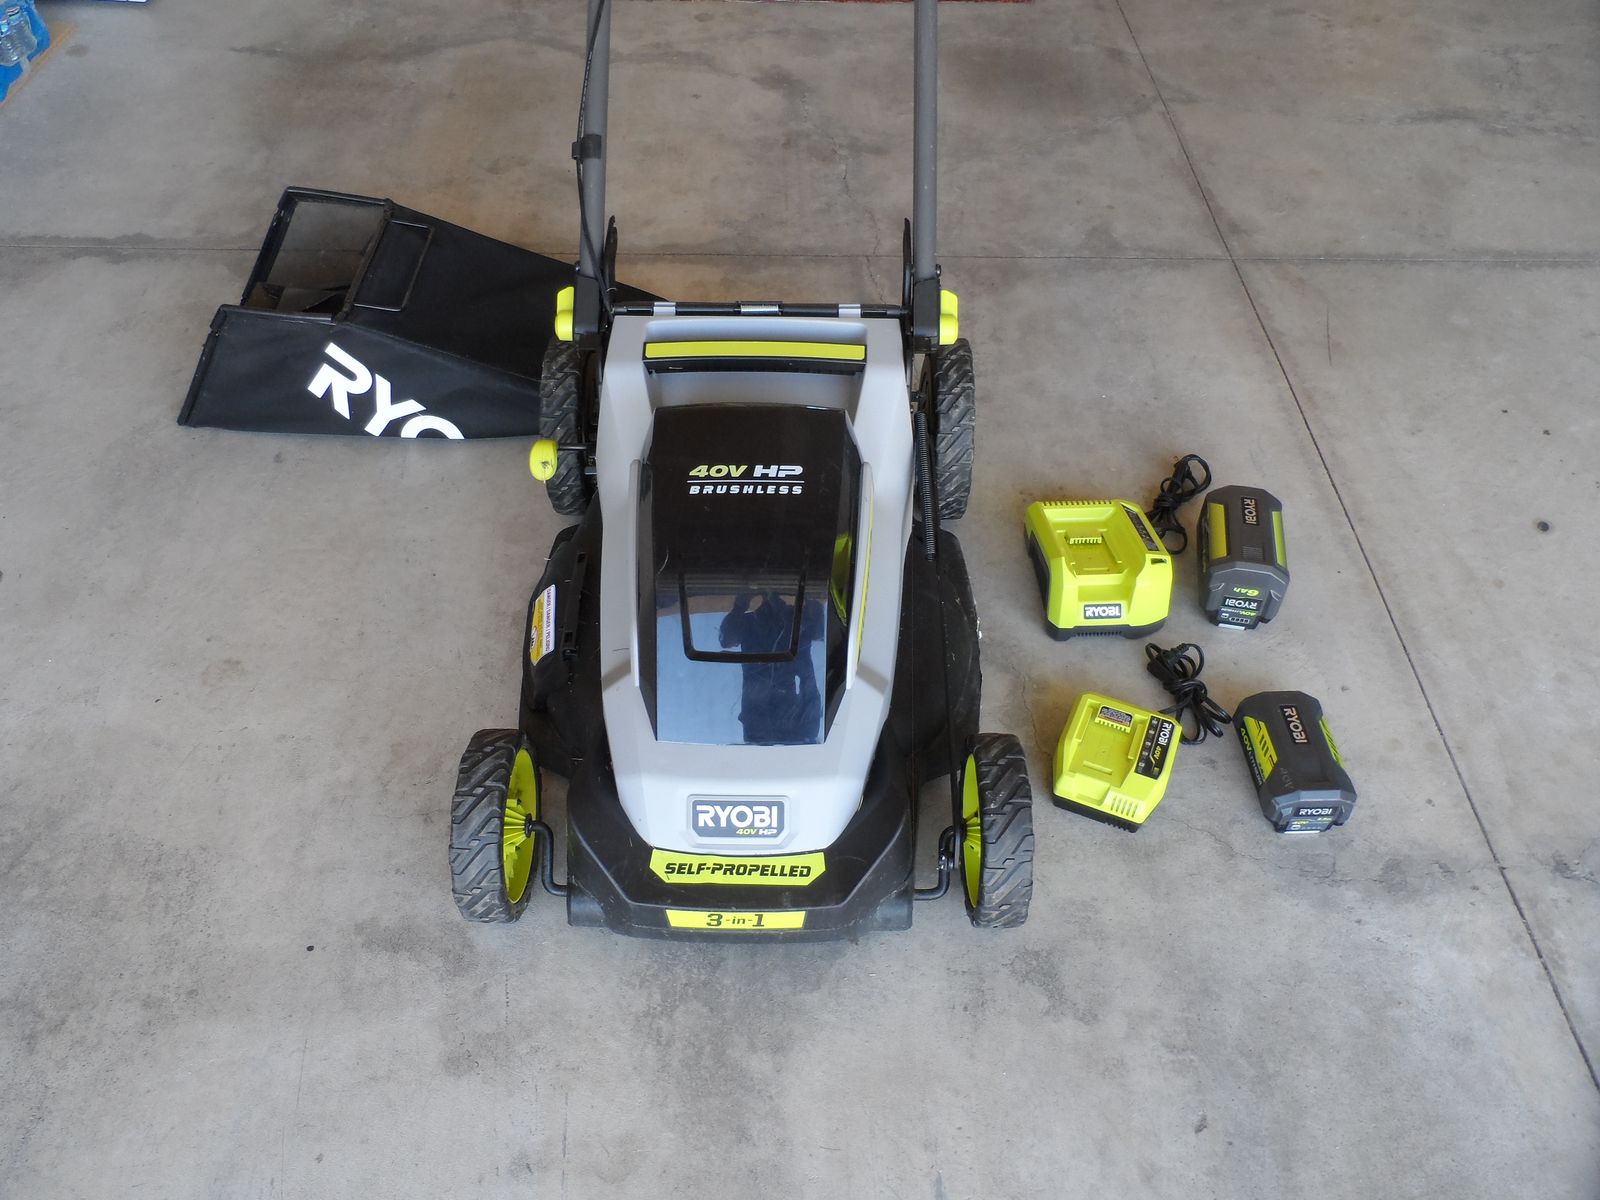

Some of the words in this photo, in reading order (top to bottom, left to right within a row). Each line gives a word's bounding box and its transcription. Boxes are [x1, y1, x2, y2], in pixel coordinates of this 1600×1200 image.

[688, 464, 748, 477] 40V
[753, 464, 803, 477] HP
[689, 485, 803, 495] BRUSHLESS
[1243, 498, 1257, 525] RYOBI
[1084, 605, 1121, 617] RYOBI
[1224, 598, 1258, 610] RYOBI
[1283, 707, 1308, 743] RYOBI
[1157, 722, 1173, 746] RYOBI
[1153, 745, 1162, 760] 40V
[696, 805, 778, 828] RYOBI
[1298, 808, 1333, 816] RYOBI
[664, 862, 812, 878] SELF-PROPELLED
